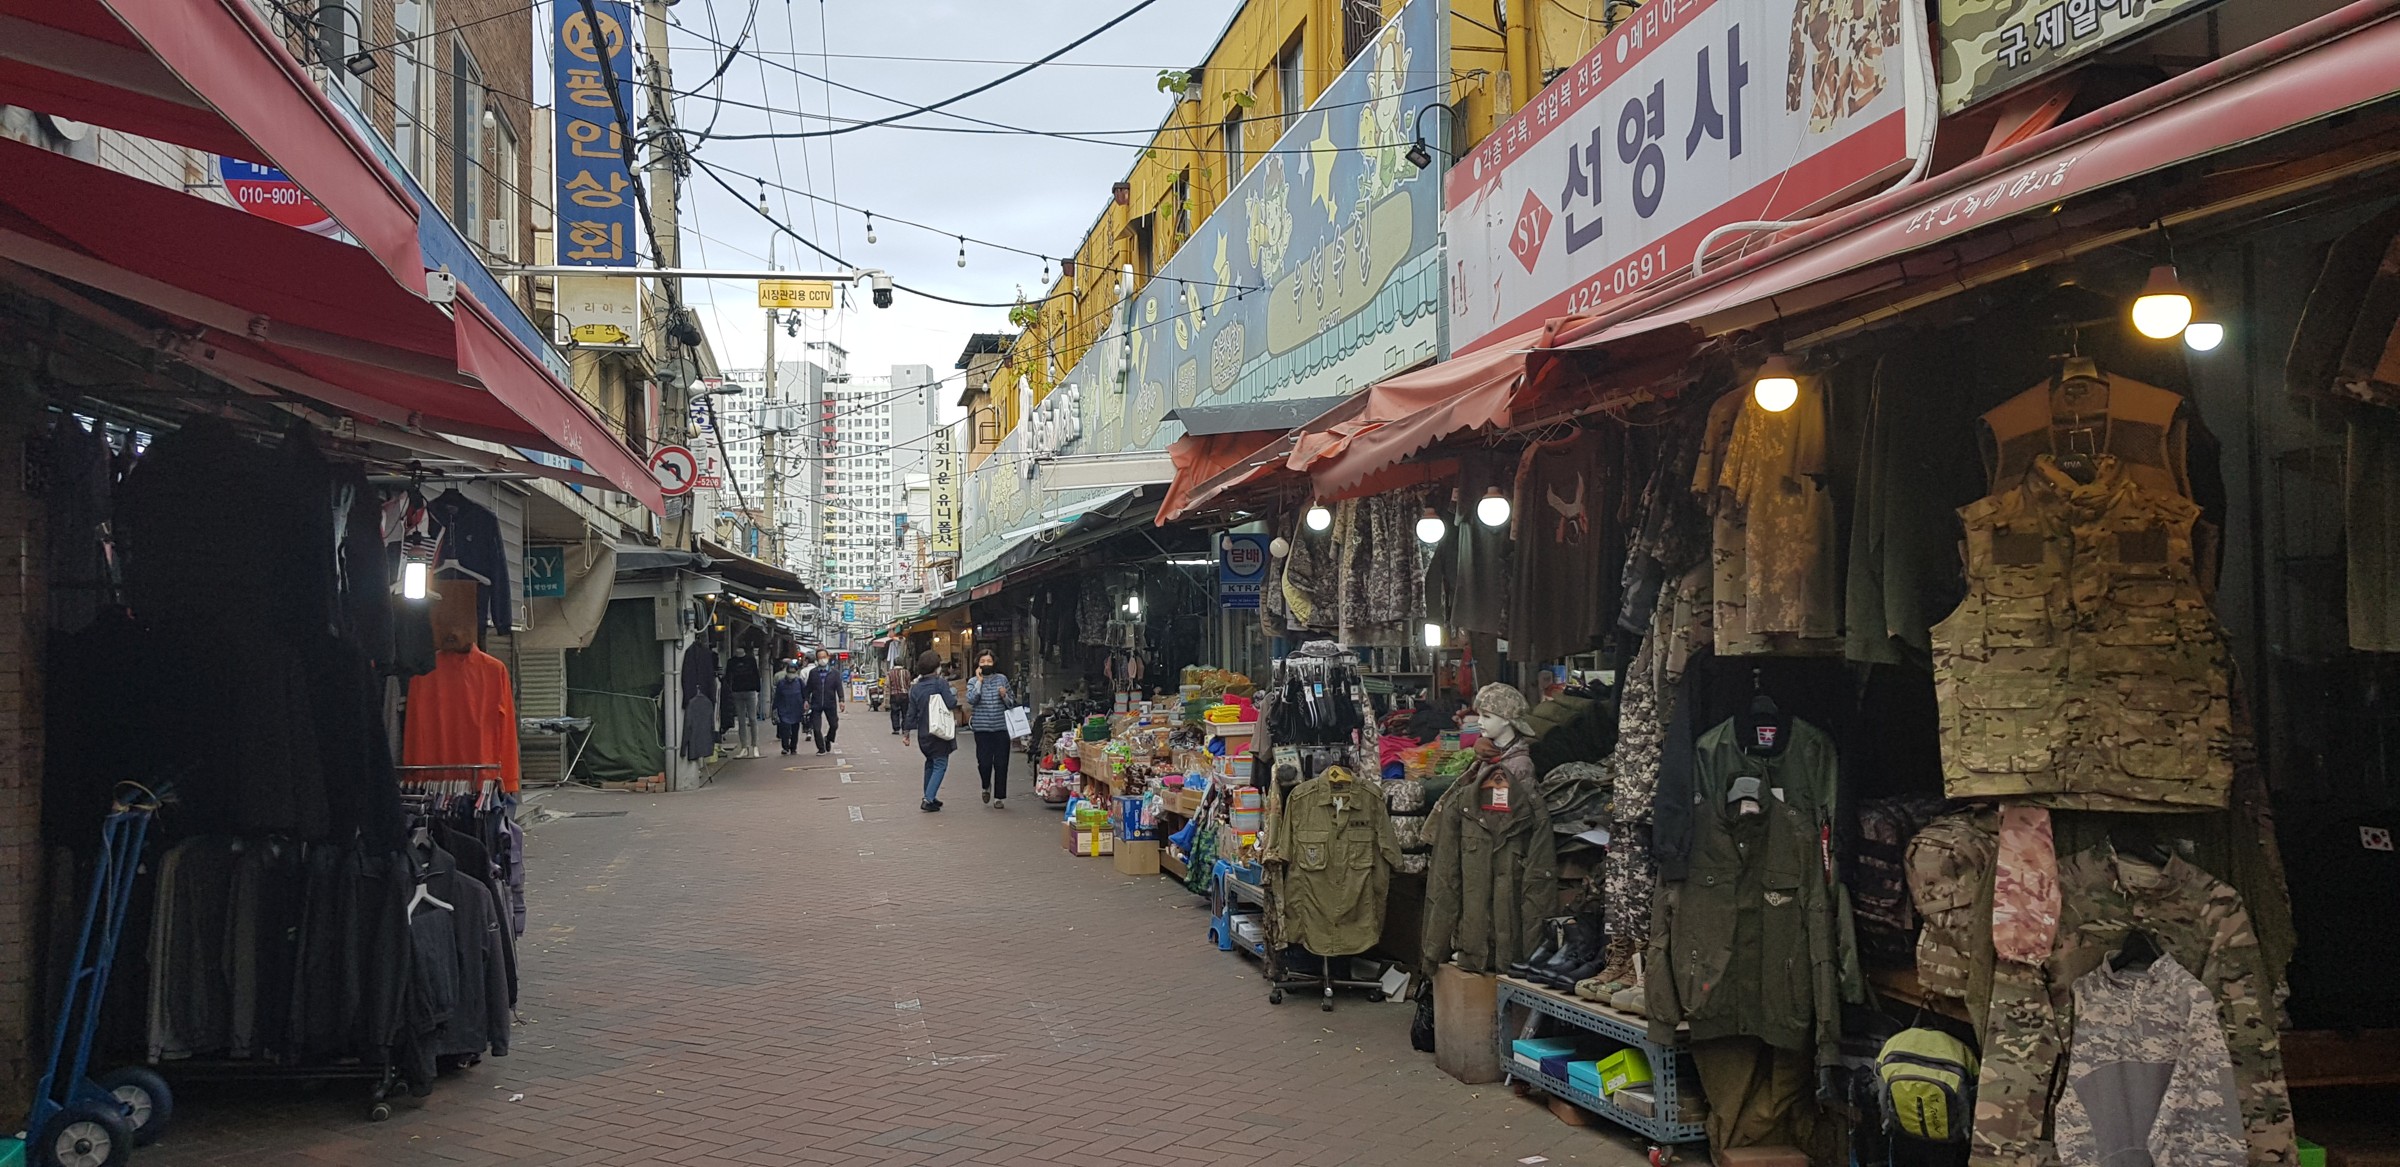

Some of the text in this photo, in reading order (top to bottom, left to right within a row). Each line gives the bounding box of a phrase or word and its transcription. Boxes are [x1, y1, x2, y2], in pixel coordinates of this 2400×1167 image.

[1483, 52, 1604, 170] 각종 군복, 작업복 전문
[1561, 22, 1748, 255] 선영사
[240, 186, 318, 206] 010-9001-
[1517, 205, 1543, 257] SY
[762, 289, 831, 301] 시장관리용 CCTV
[1566, 244, 1668, 315] 422-0691
[1231, 548, 1260, 563] 담배
[1228, 584, 1260, 592] KTRA
